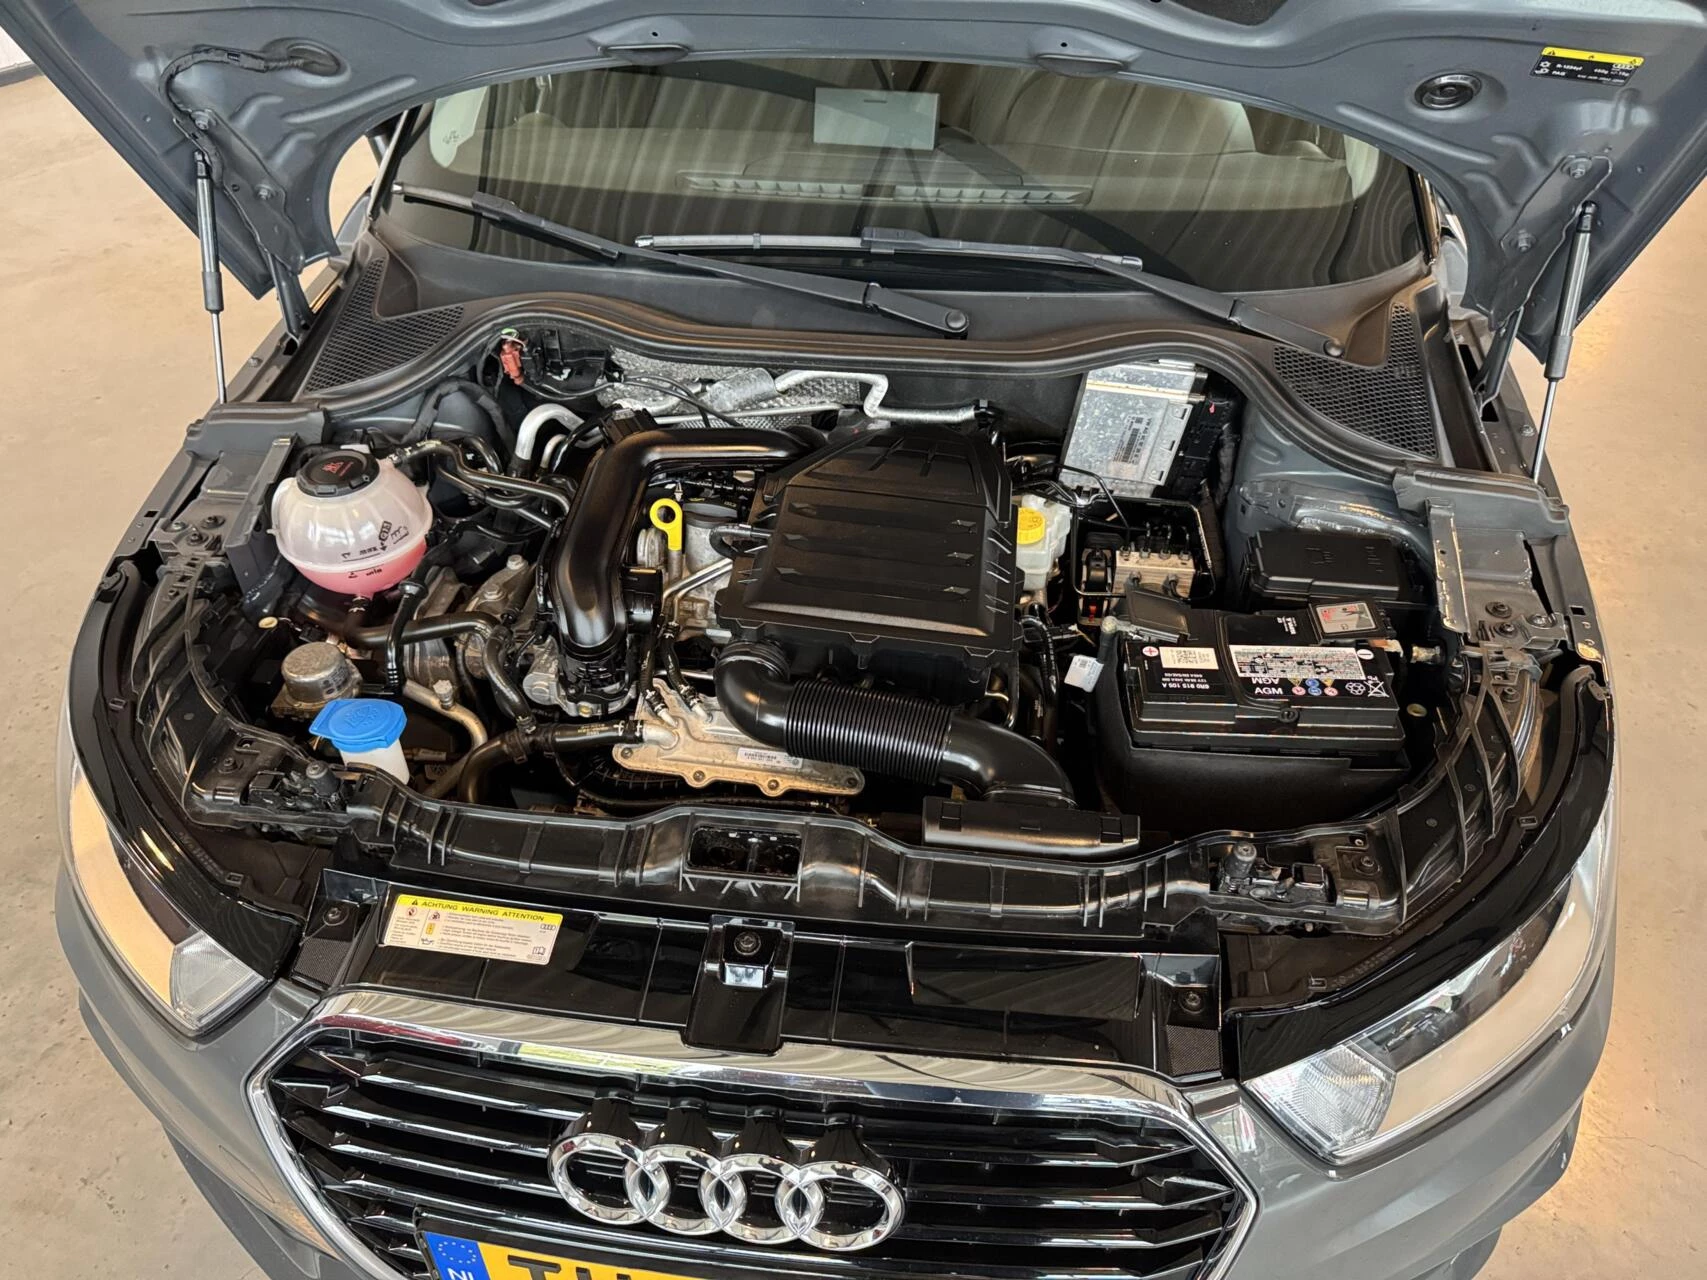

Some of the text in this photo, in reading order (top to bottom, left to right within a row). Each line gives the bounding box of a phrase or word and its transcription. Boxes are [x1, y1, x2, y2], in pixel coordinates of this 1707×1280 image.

[1251, 677, 1279, 685] AGM
[1254, 687, 1284, 695] AGM
[422, 901, 545, 922] ACHTUNG WARNING ATTENTION
